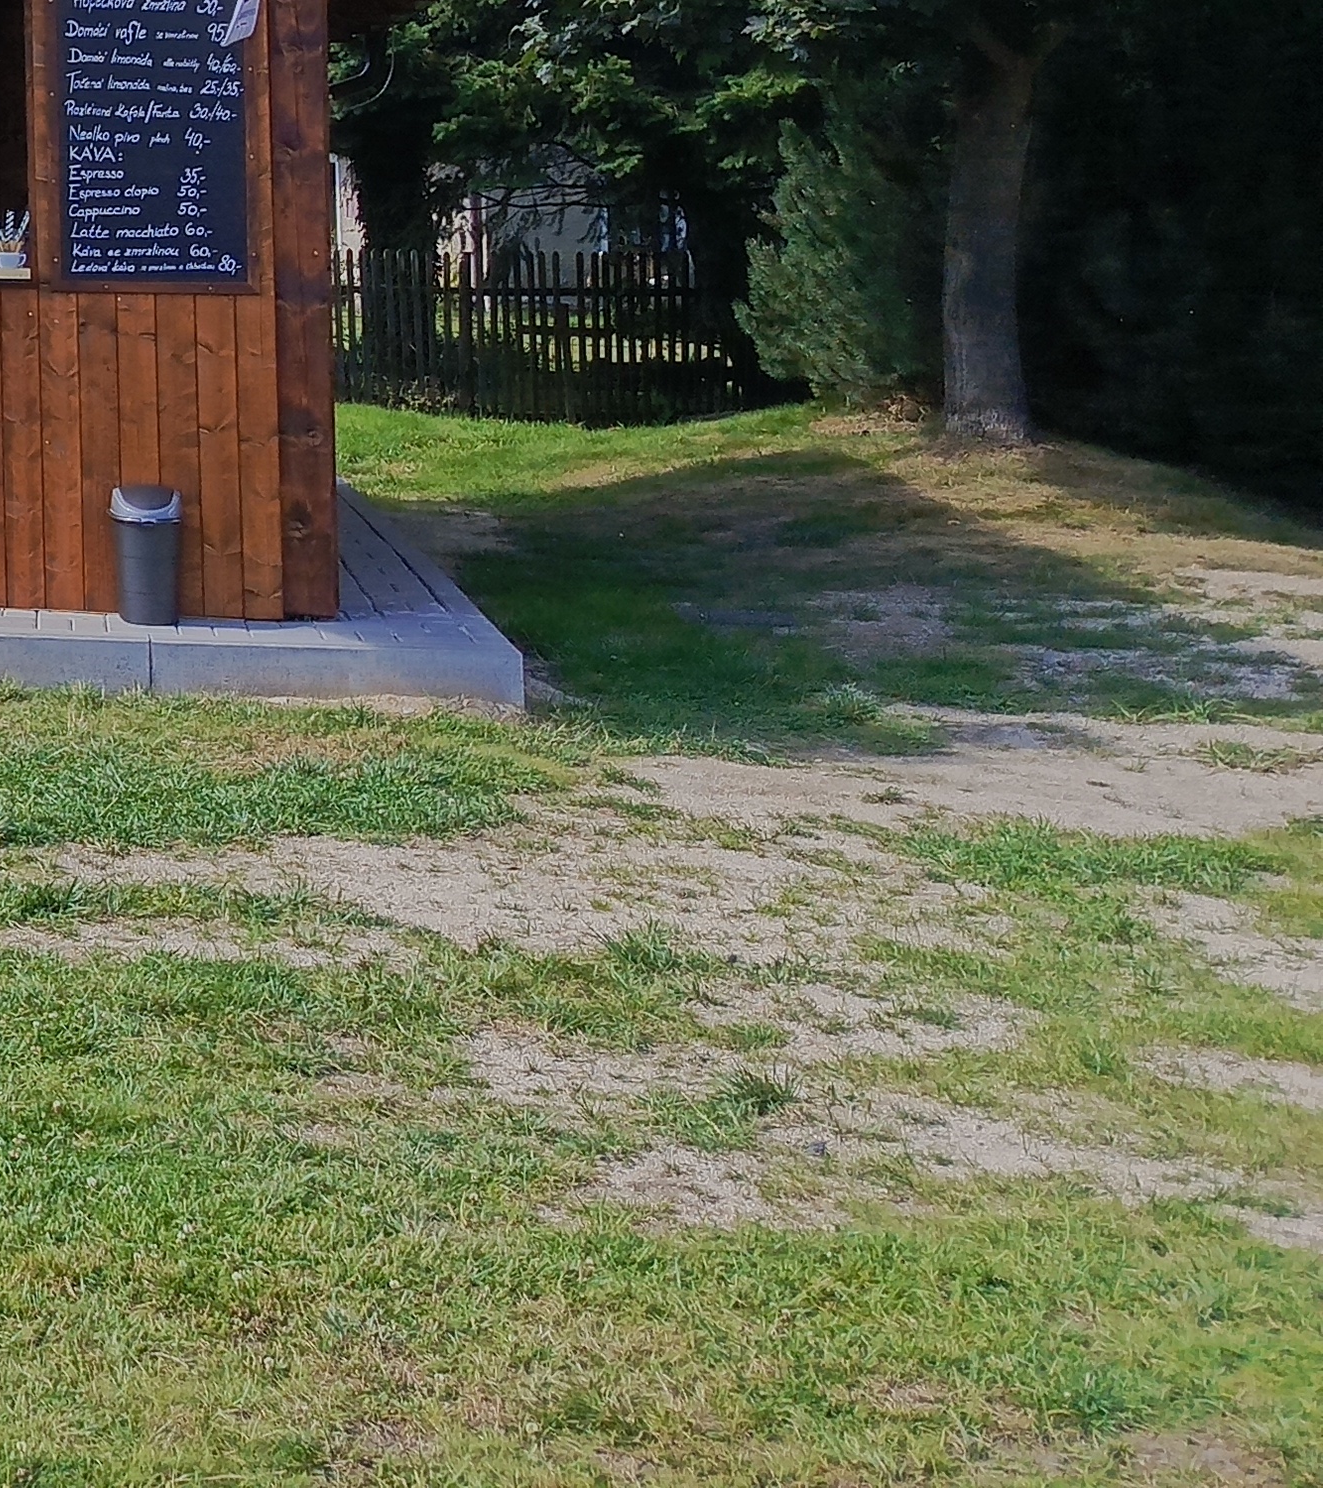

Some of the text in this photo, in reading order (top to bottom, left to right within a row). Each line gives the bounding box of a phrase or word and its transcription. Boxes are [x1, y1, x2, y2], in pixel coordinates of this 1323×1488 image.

[115, 19, 148, 46] vafle
[69, 124, 110, 142] Nealko
[114, 131, 141, 148] pivo
[184, 127, 212, 150] 40,-
[68, 164, 207, 186] Espresso 35,-
[68, 184, 208, 203] Espresso dopio 50,-
[68, 201, 208, 222] Cappuccino 50,-
[70, 221, 214, 239] Latte macchiato 60,-
[189, 243, 219, 258] 60,-
[217, 254, 243, 276] 80,-
